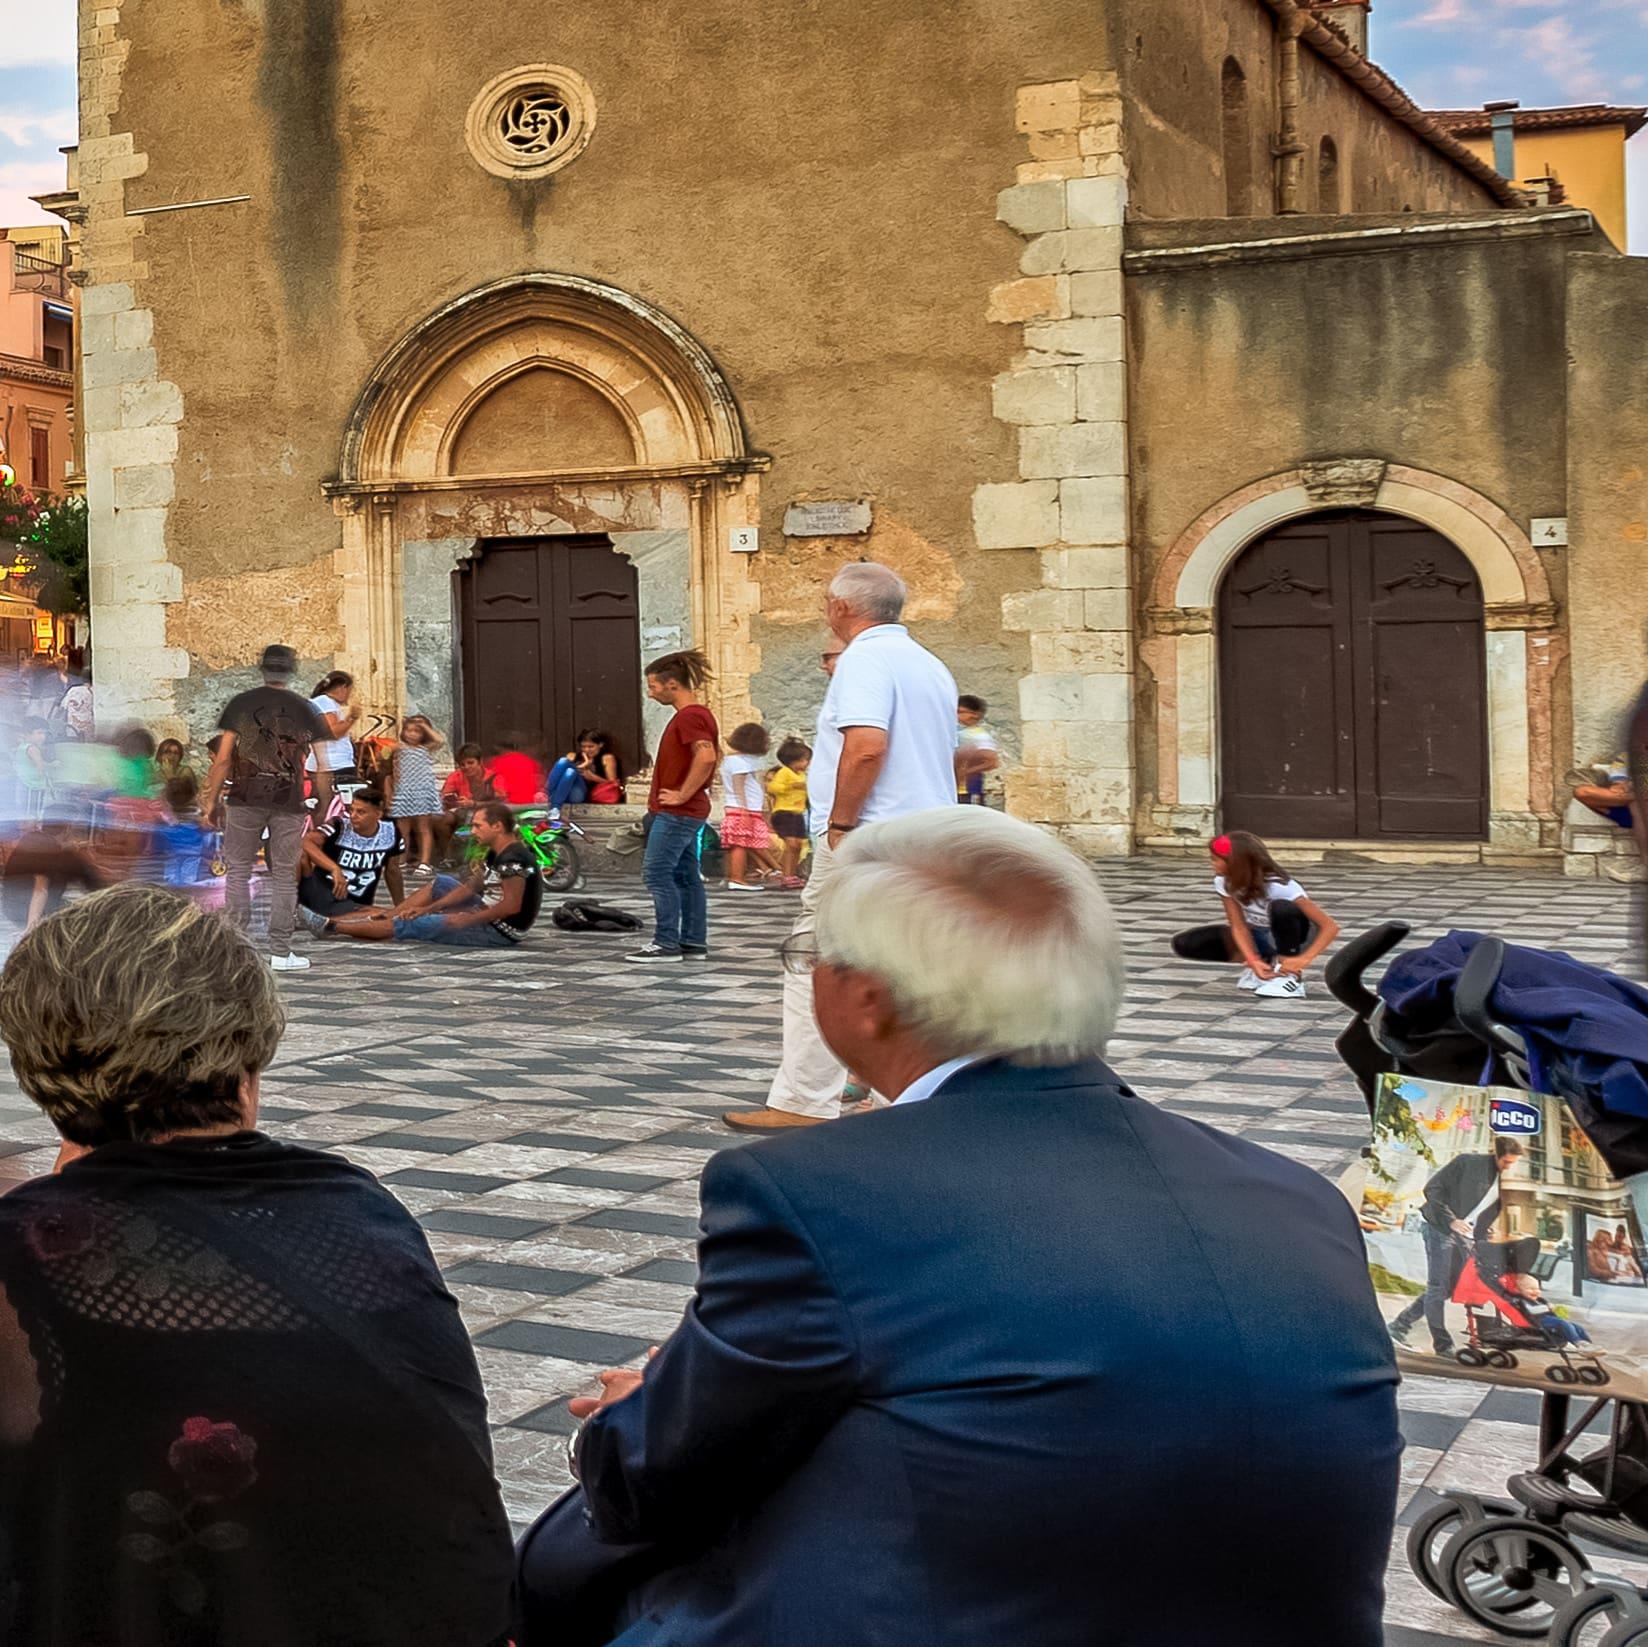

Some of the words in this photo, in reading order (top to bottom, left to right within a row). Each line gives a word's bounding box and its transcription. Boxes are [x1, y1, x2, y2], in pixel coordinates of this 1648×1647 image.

[1544, 526, 1557, 538] 4
[739, 534, 748, 545] 3
[1491, 1102, 1535, 1129] icco
